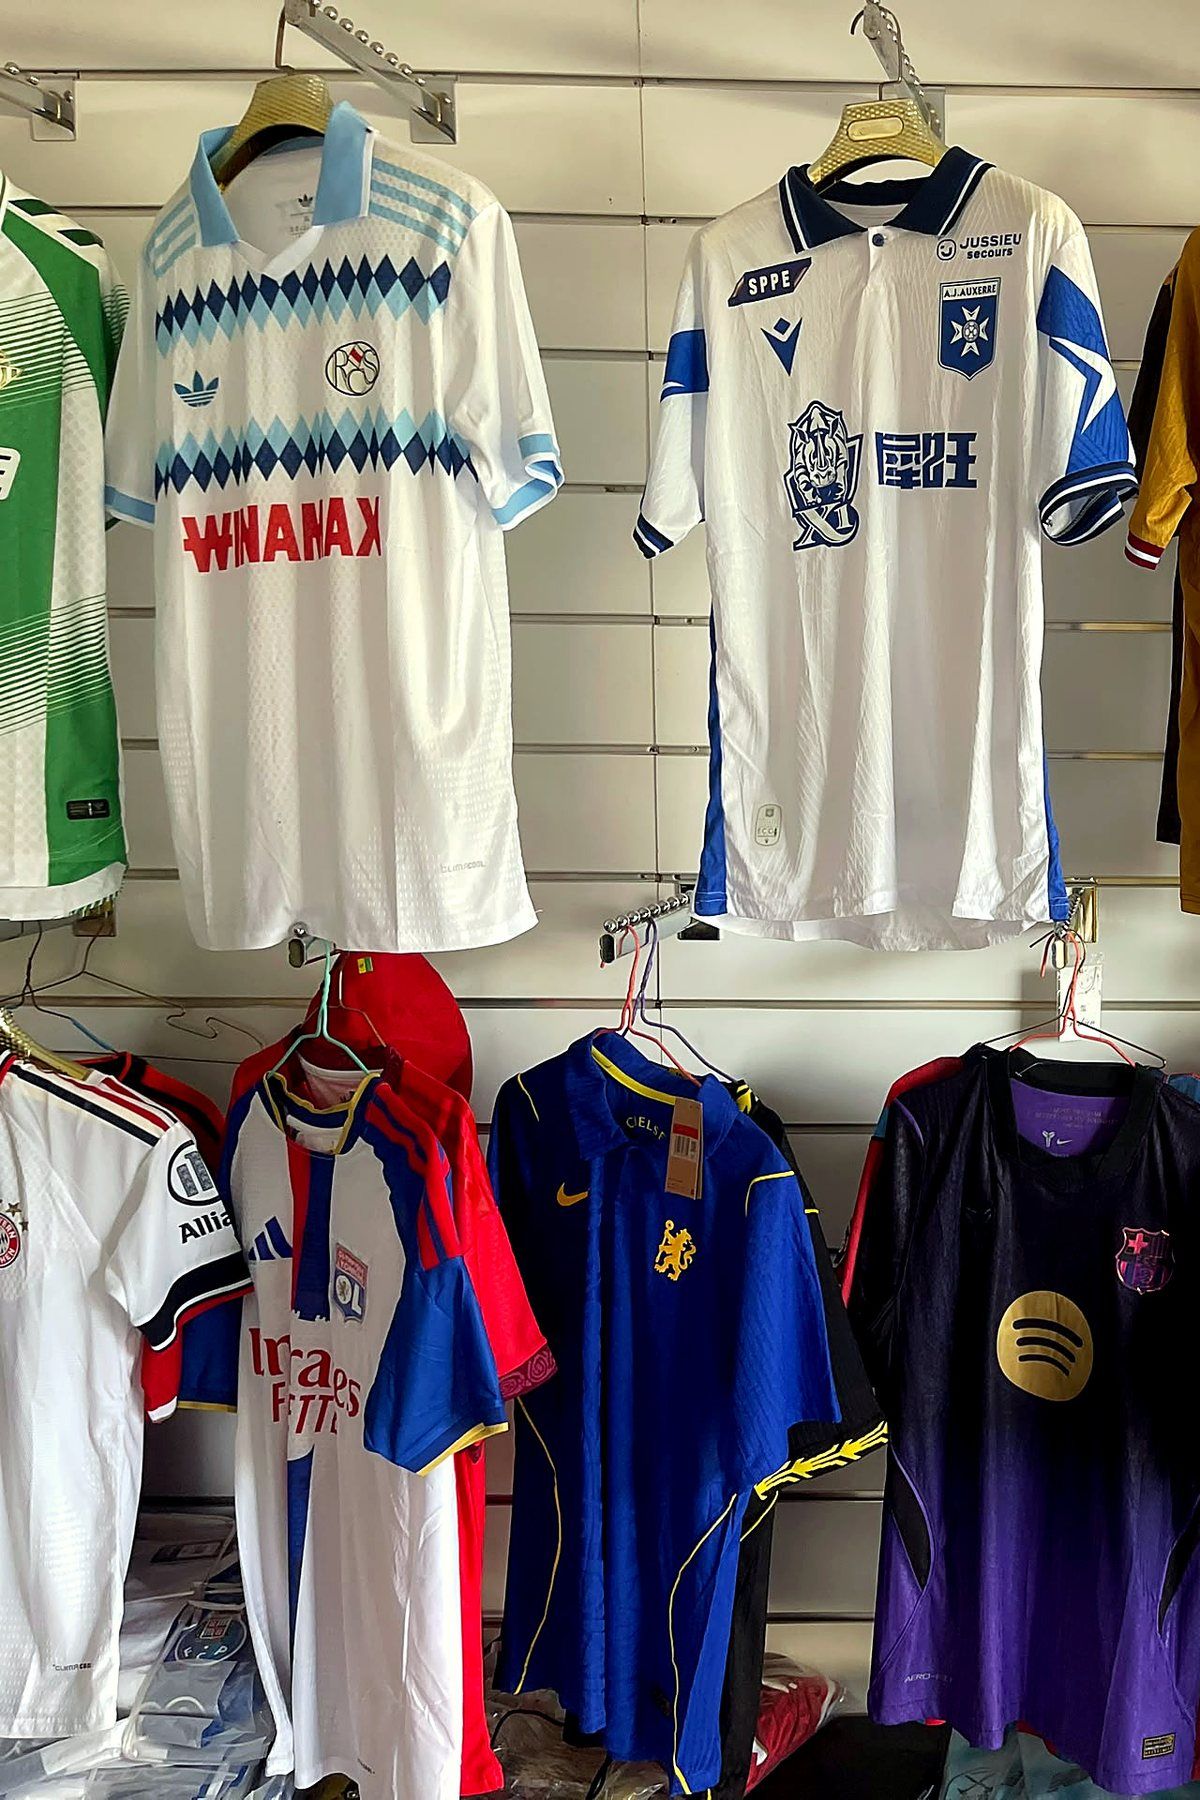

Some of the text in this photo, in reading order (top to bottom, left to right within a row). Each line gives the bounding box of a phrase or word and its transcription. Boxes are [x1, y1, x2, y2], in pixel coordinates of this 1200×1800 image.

[960, 233, 1022, 250] JUSSIEU
[966, 246, 1013, 260] secours
[748, 269, 791, 296] SPPE
